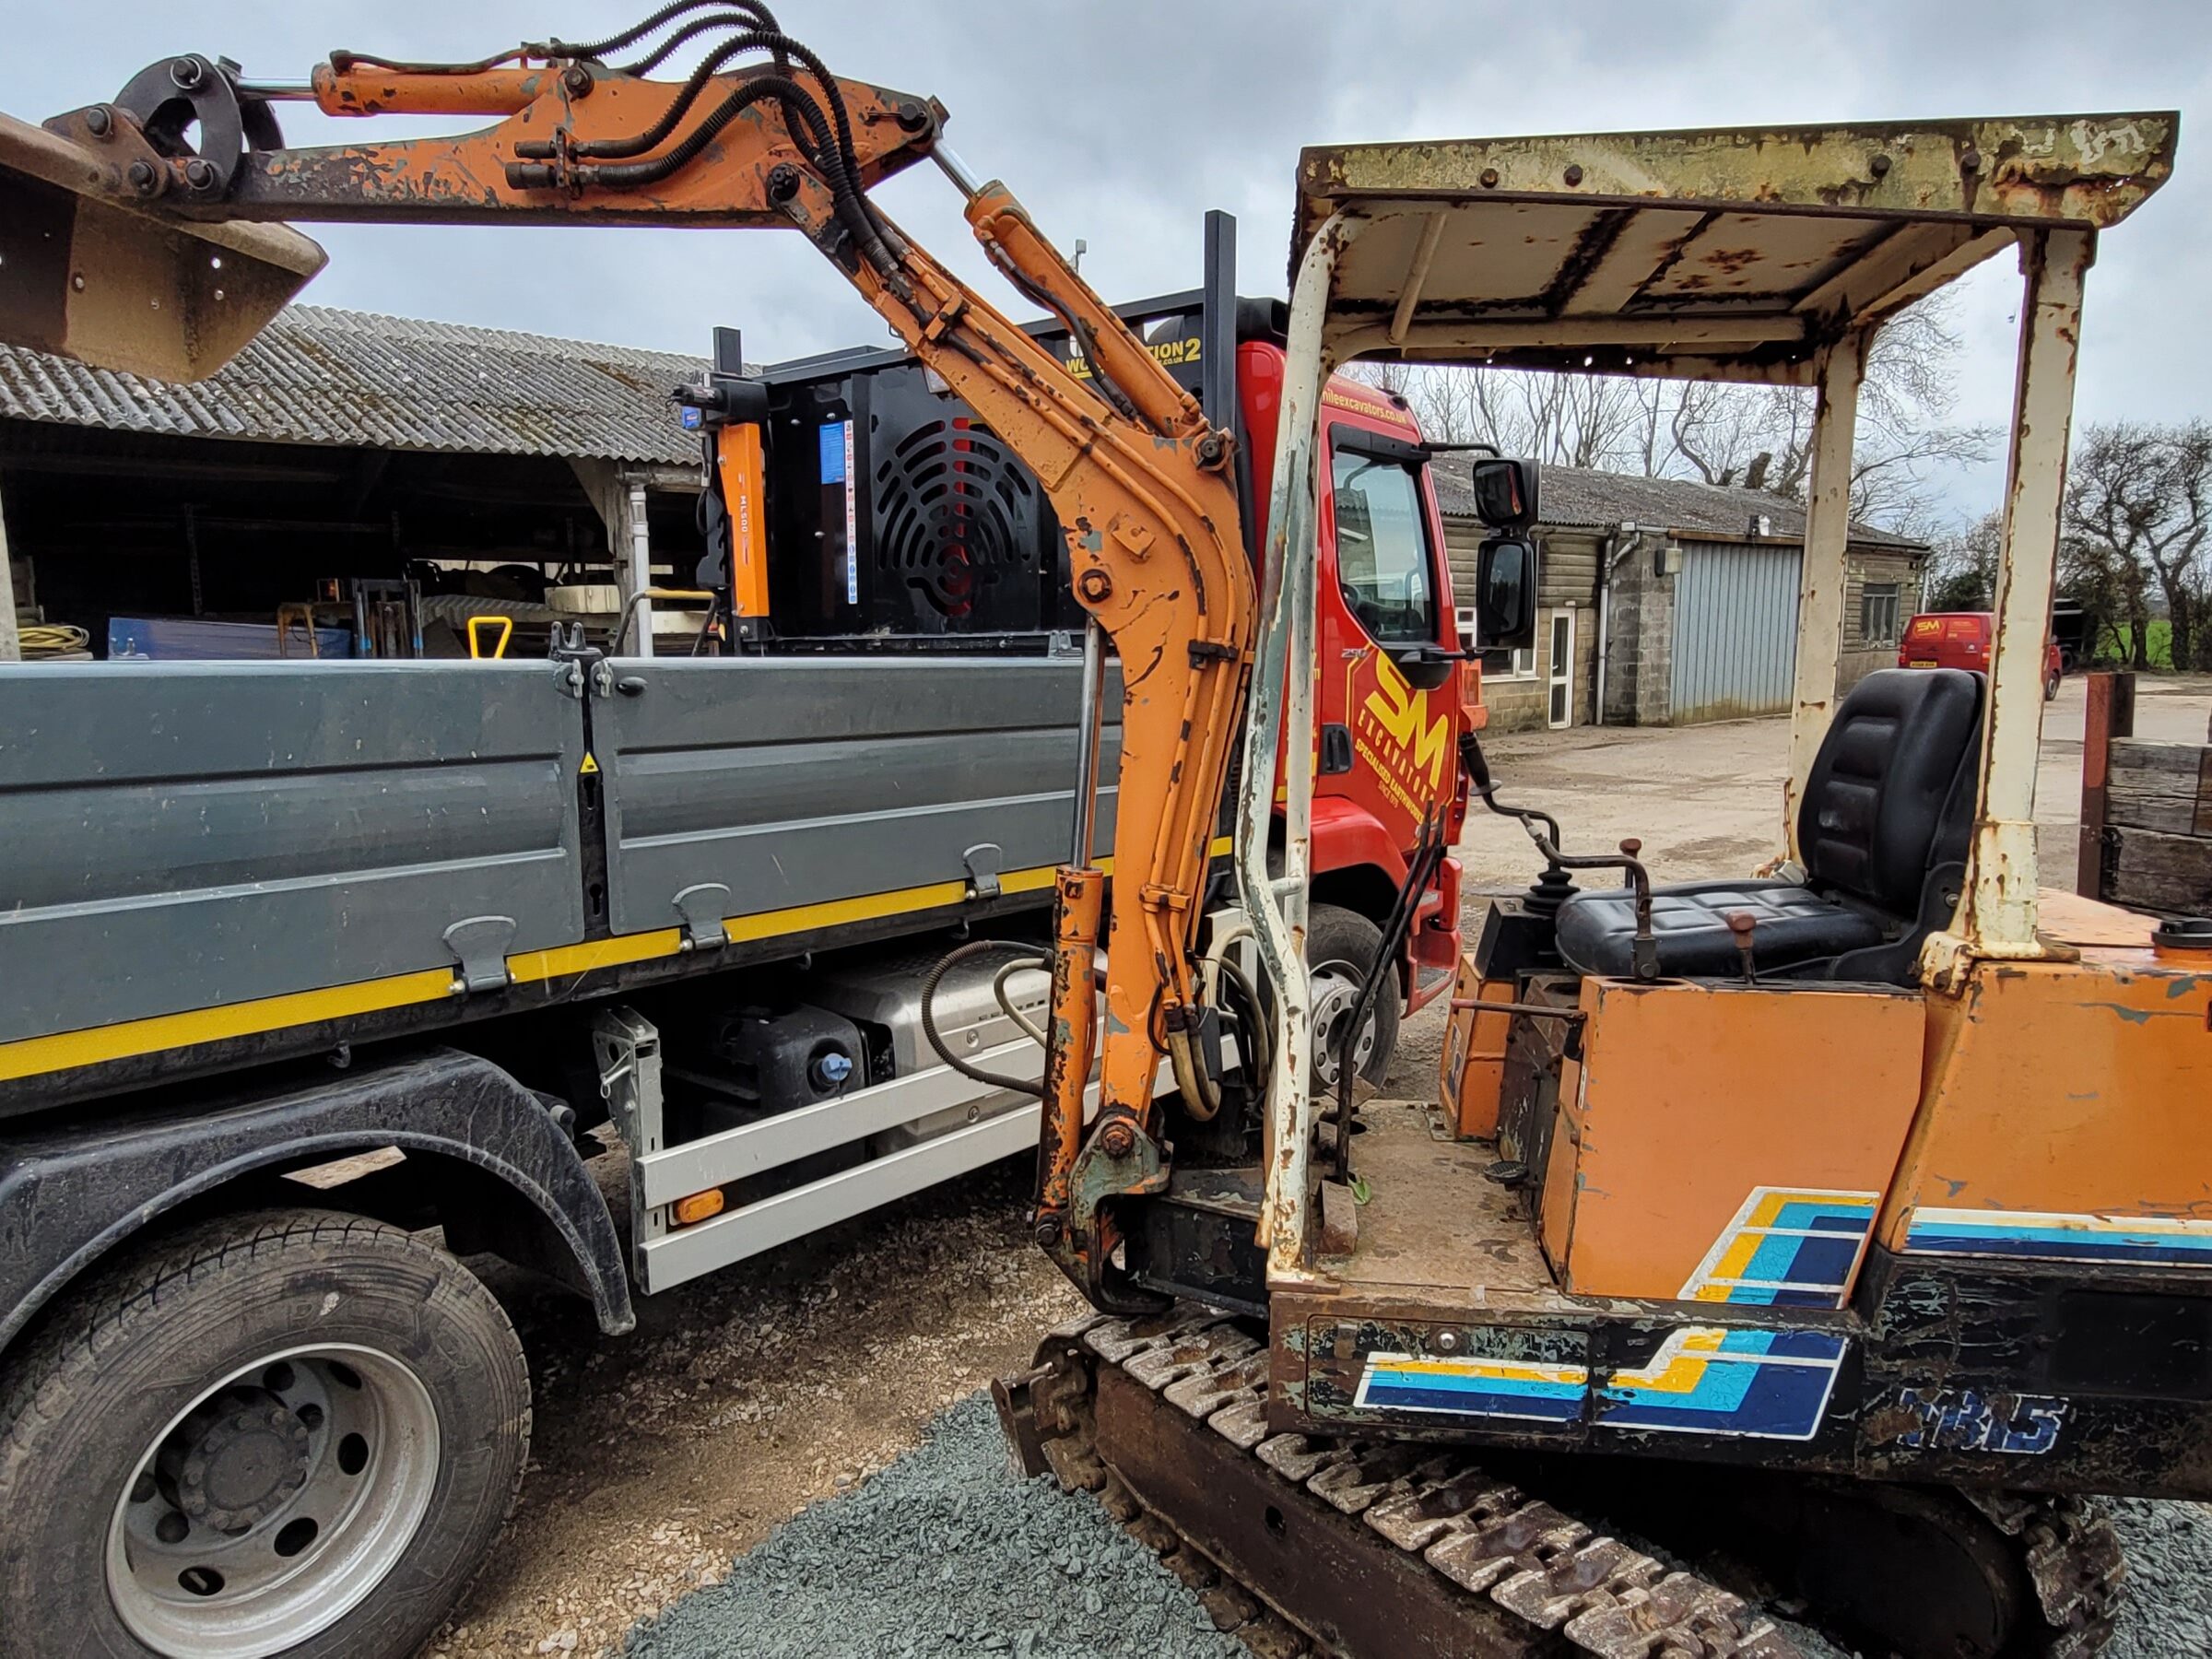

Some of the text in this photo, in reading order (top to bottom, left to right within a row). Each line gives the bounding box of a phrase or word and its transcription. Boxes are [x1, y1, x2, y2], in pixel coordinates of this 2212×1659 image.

[1184, 337, 1202, 362] 2
[1917, 619, 1940, 632] SM
[1364, 649, 1449, 792] SM
[1355, 738, 1391, 784] SPECIALISED
